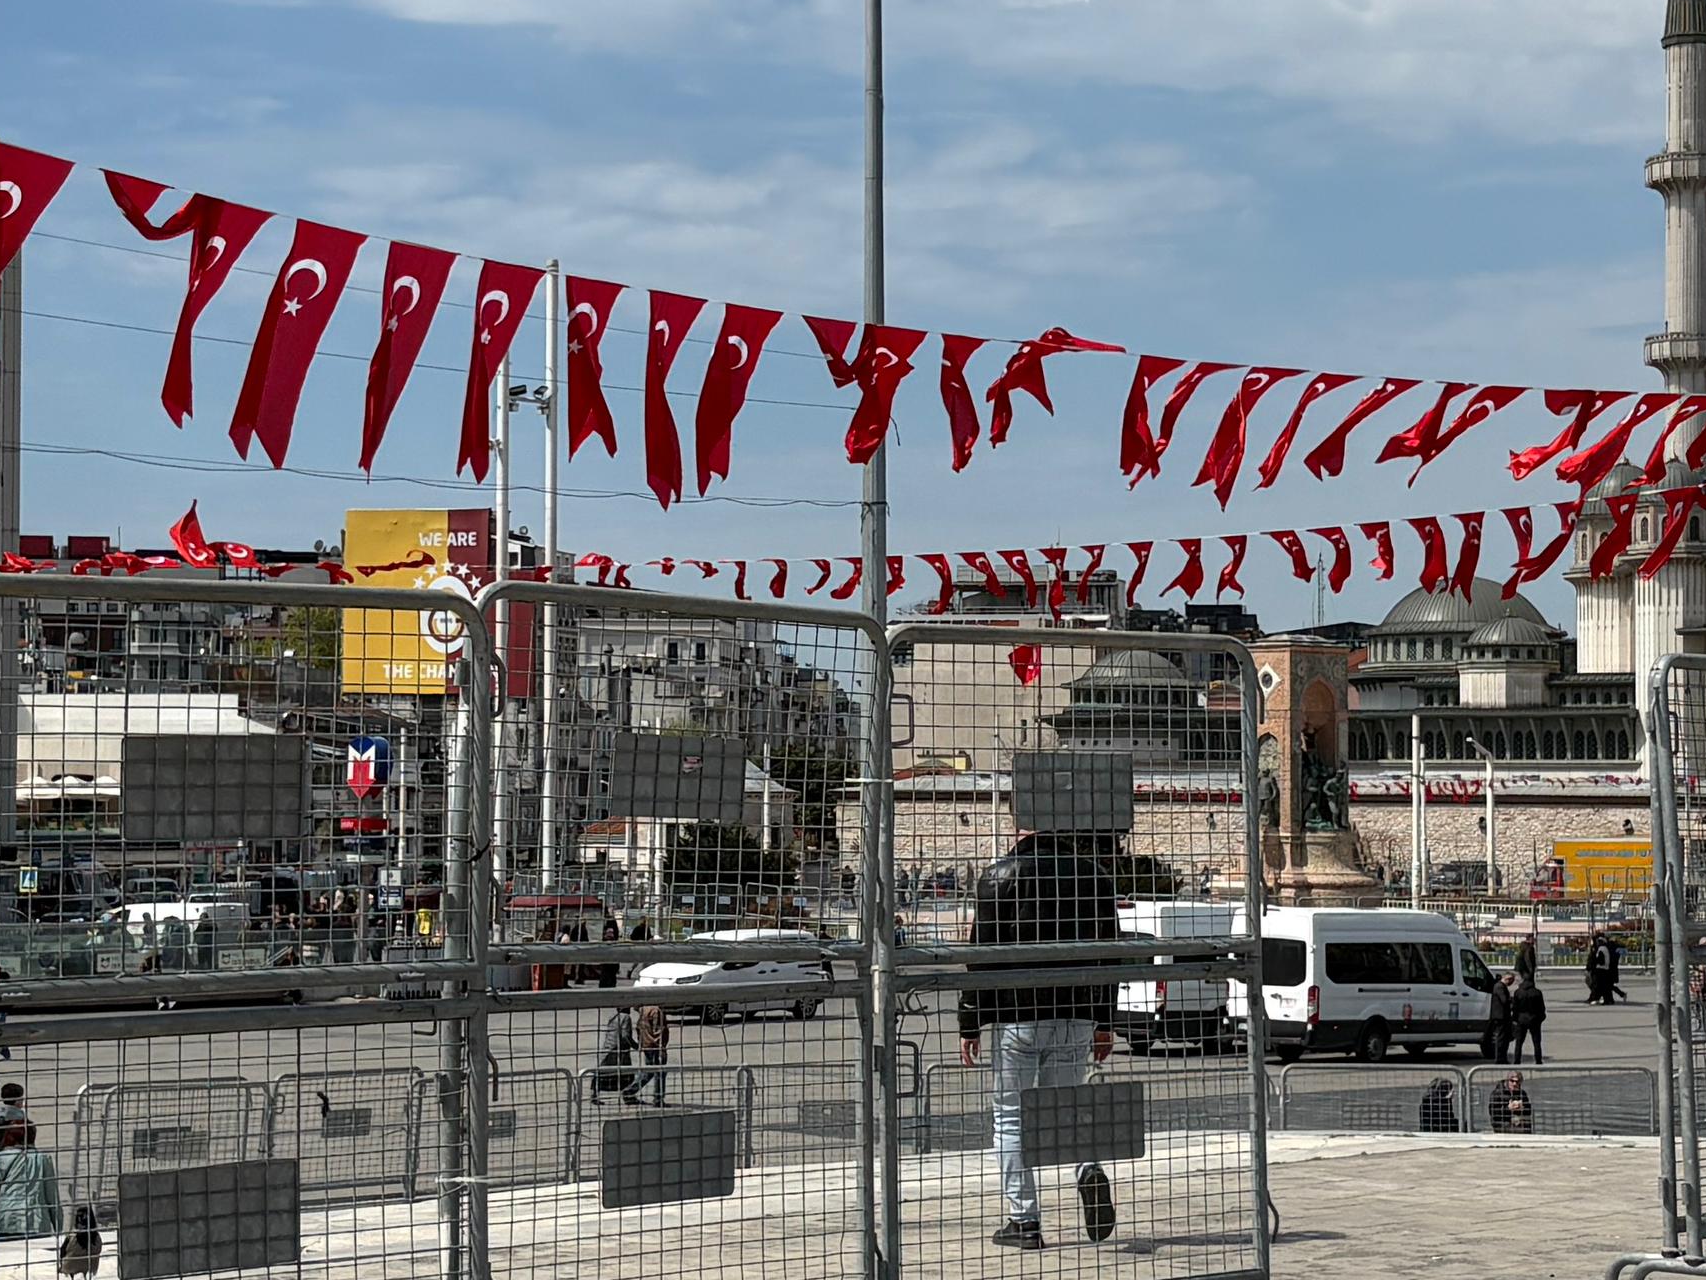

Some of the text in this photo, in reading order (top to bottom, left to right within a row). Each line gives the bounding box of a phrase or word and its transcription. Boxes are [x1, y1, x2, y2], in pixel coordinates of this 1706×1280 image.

[418, 532, 477, 547] WE ARE
[383, 663, 413, 679] THE
